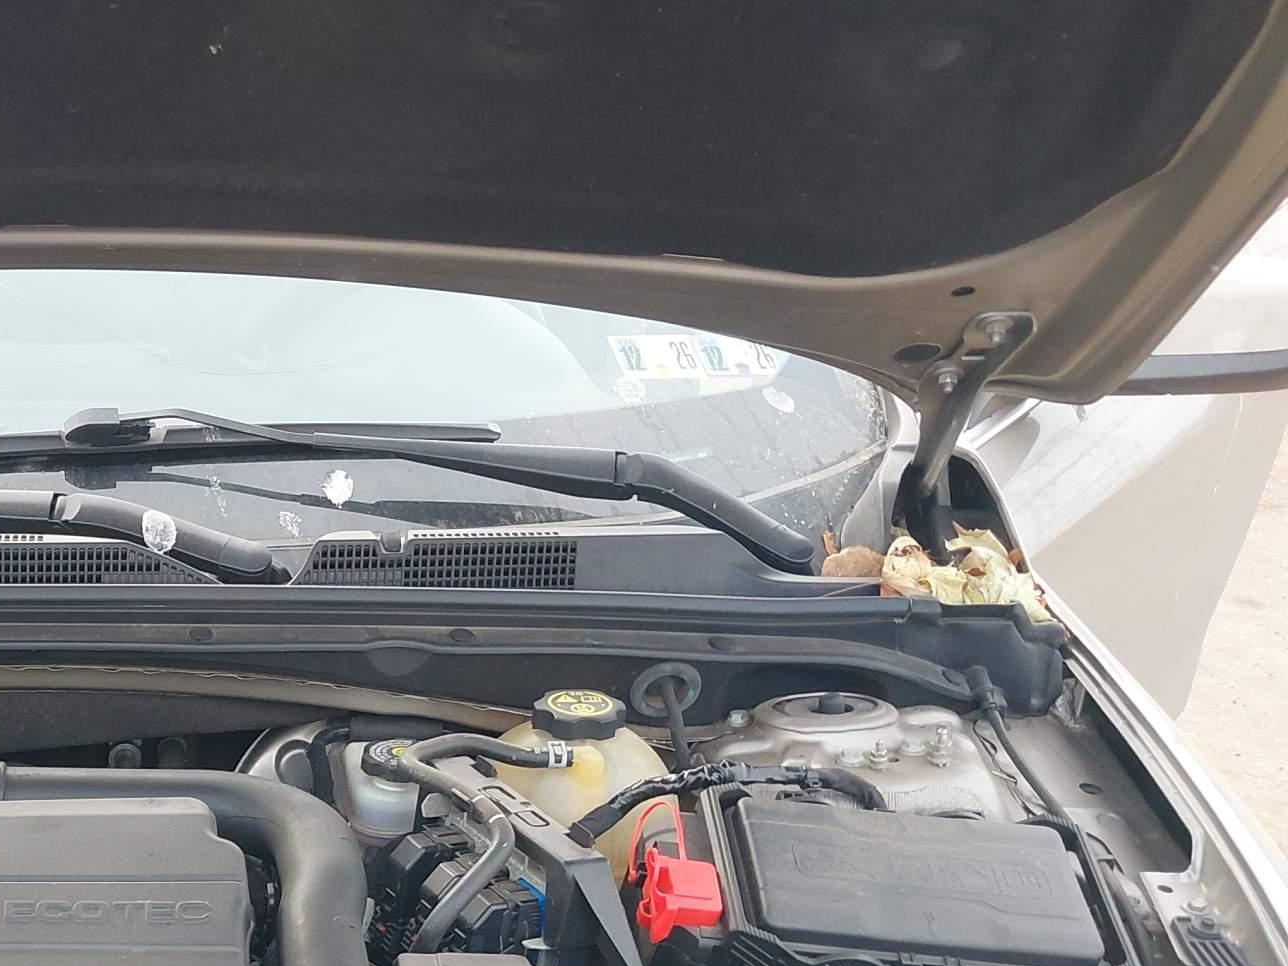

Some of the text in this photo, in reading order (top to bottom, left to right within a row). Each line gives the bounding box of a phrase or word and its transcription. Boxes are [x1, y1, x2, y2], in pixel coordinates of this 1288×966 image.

[620, 341, 697, 371] 12 26
[701, 345, 729, 371] 12
[3, 899, 213, 924] ECOTEC
